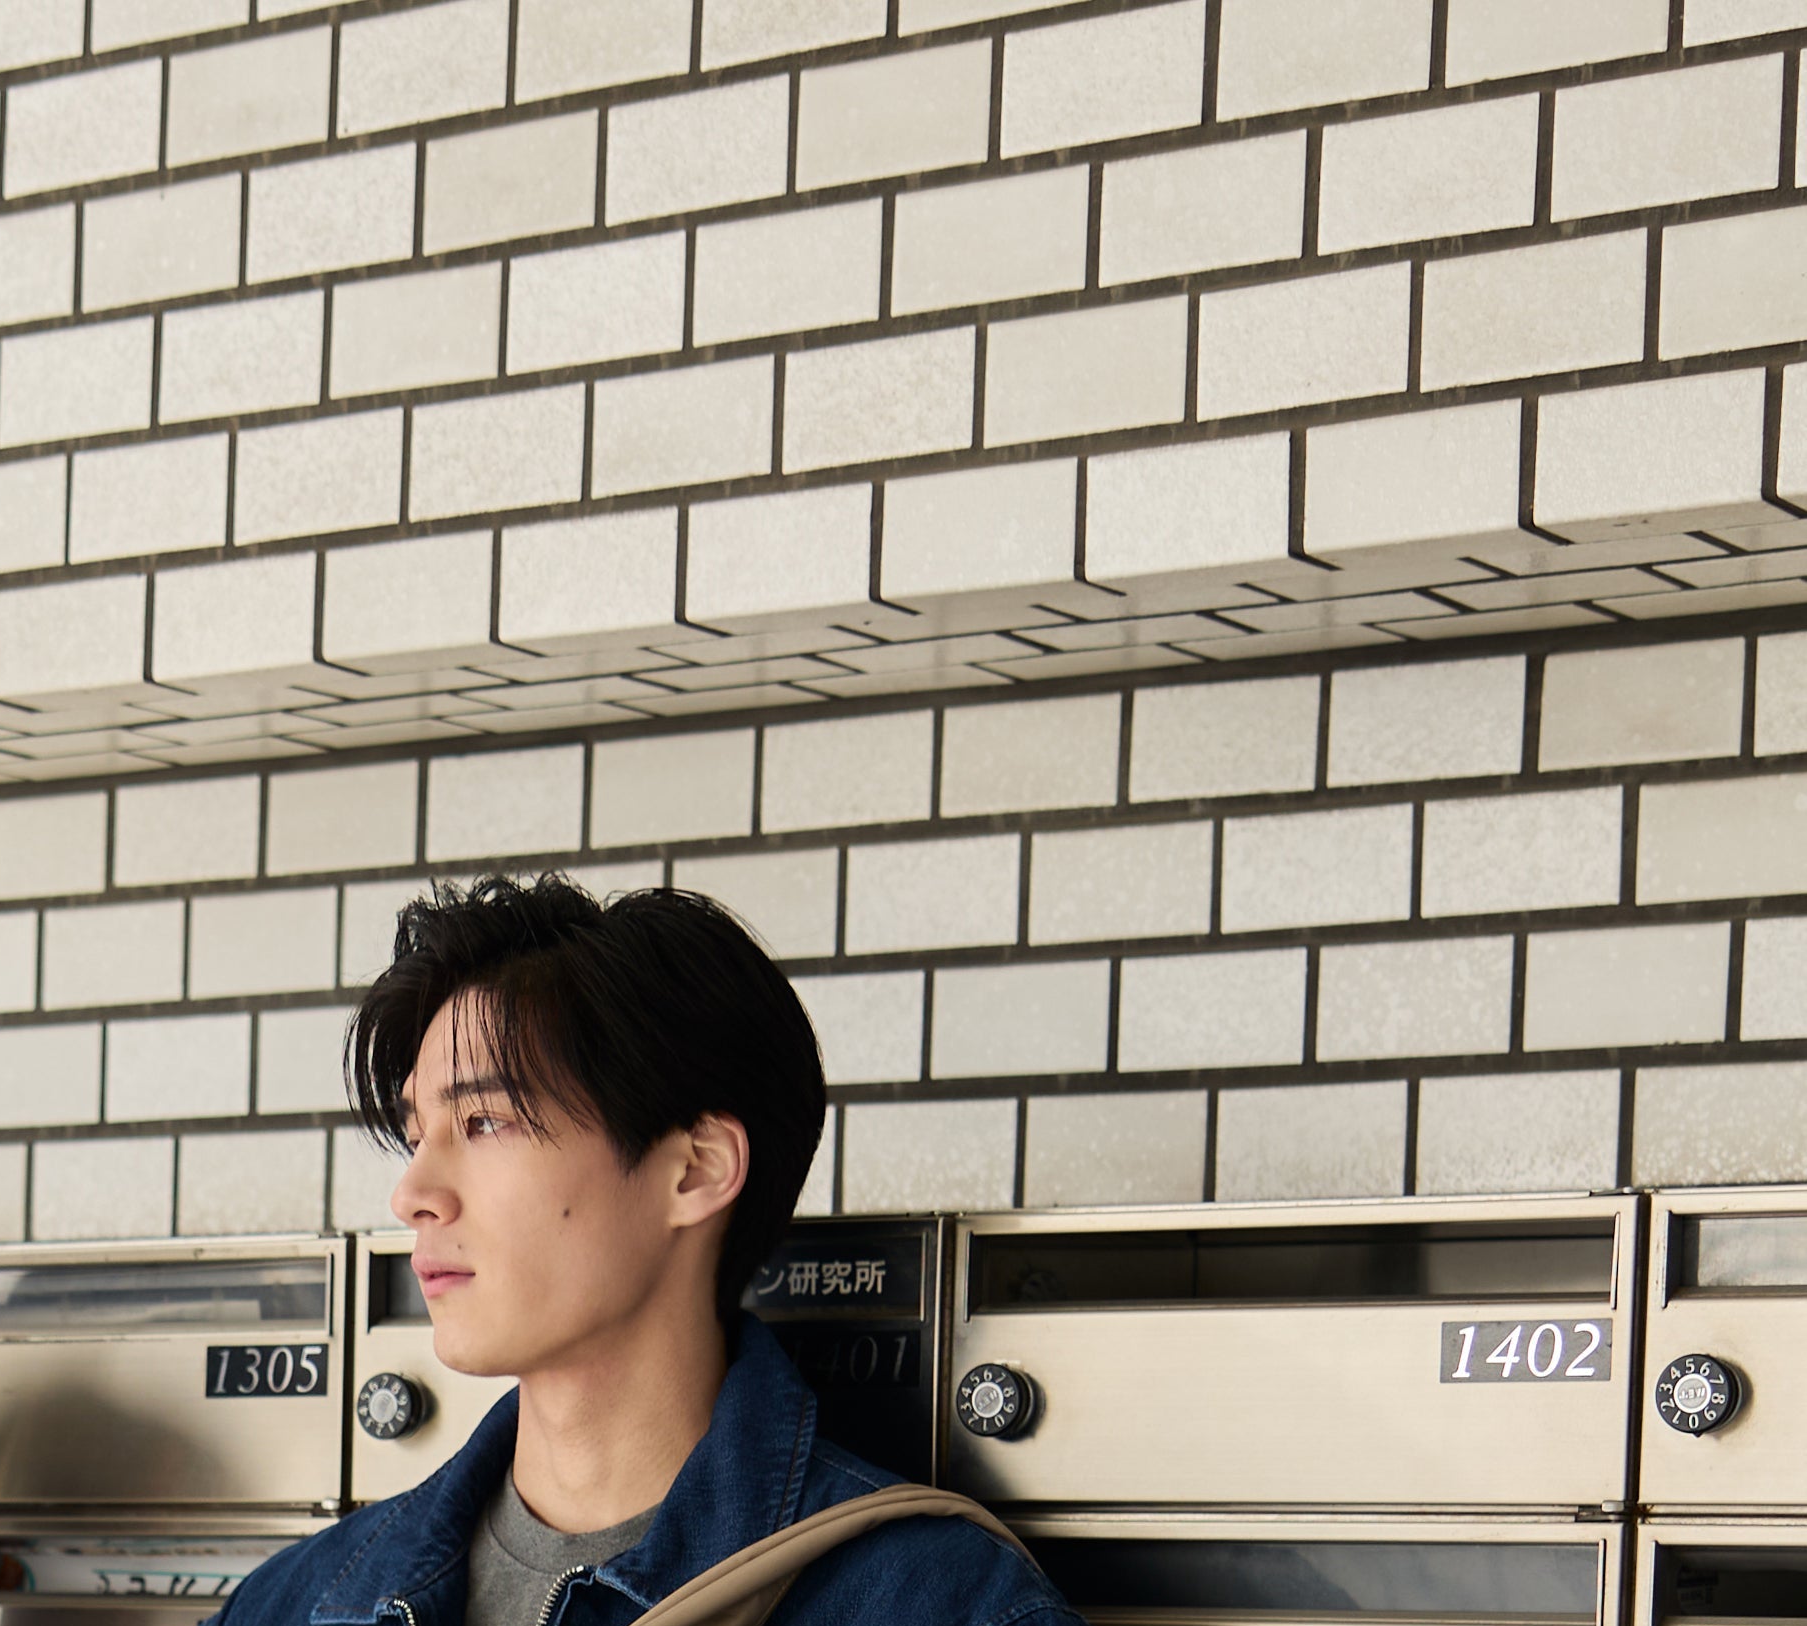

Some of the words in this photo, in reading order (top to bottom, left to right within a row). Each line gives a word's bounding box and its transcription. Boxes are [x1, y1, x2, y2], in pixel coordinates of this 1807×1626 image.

[756, 1260, 886, 1296] ン研究所
[214, 1346, 320, 1394] 1305
[1449, 1324, 1602, 1378] 1402
